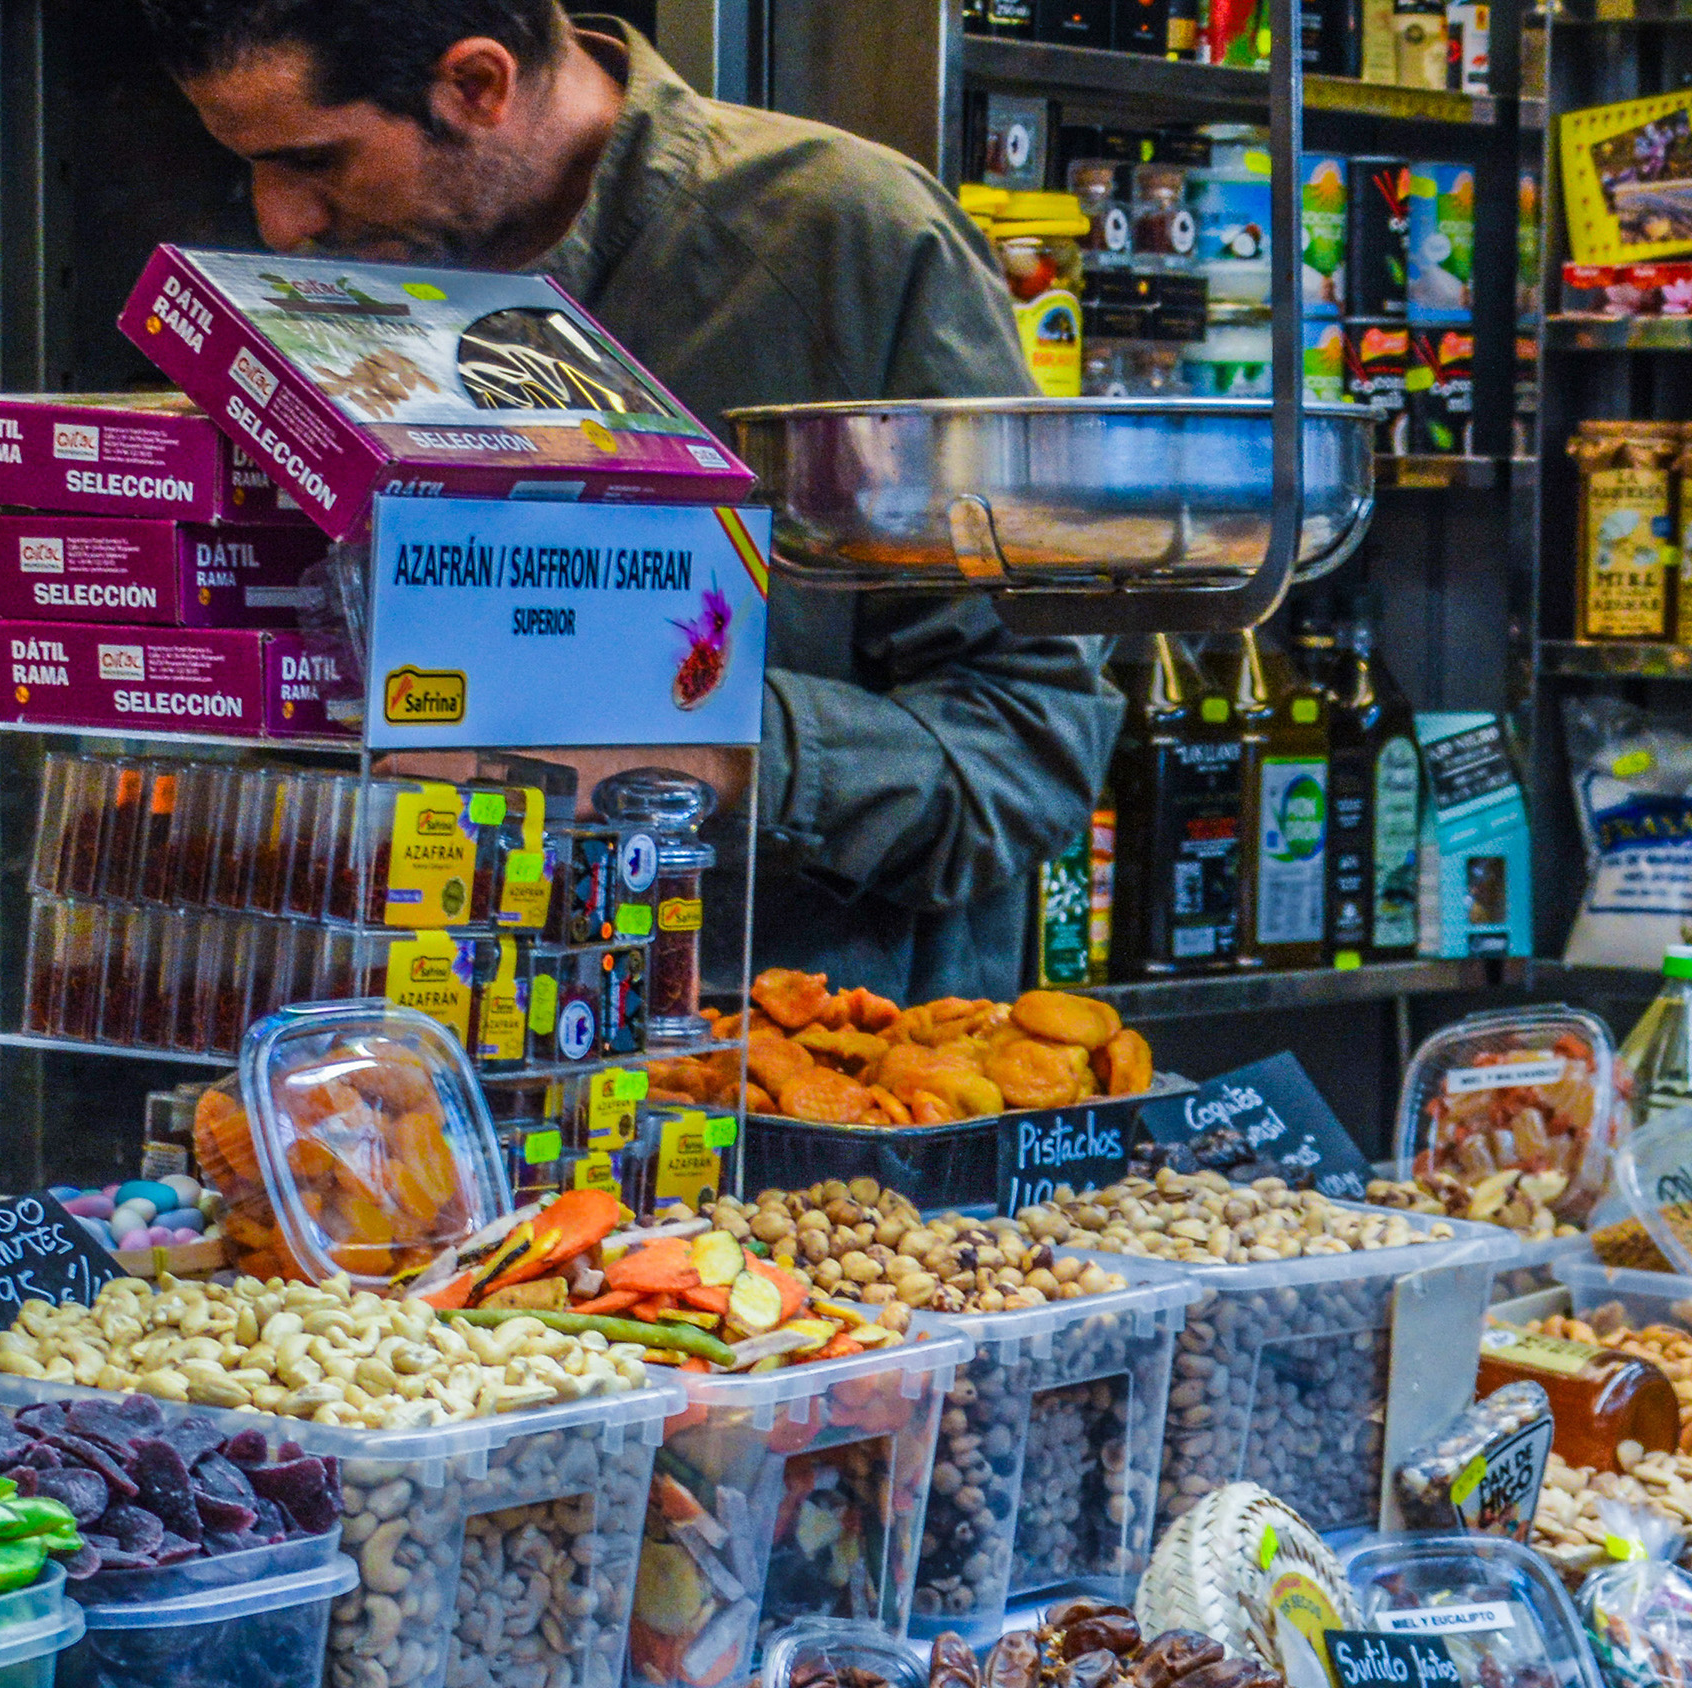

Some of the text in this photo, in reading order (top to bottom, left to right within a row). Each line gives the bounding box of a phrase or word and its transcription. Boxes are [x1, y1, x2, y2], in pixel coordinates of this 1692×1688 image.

[162, 275, 214, 335] DÁTIL
[153, 297, 205, 355] RAMA
[226, 395, 337, 511] SELECCIÓN
[408, 430, 537, 454] SELECCIÓN
[66, 469, 194, 502] SELECCIÓN
[196, 541, 260, 568] DÁTIL
[394, 537, 493, 587] AZAFRÁN
[509, 547, 598, 589] SAFFRON
[615, 550, 692, 591] SAFRAN
[197, 570, 237, 588] RAMA
[1595, 572, 1657, 588] MIEL
[34, 581, 157, 608] SELECCIÓN
[513, 607, 576, 636] SUPERIOR
[11, 636, 69, 663] DÁTIL
[12, 664, 69, 686] RAMA
[281, 653, 340, 681] DÁTIL
[114, 690, 242, 717] SELECCIÓN
[281, 684, 320, 700] RAMA
[404, 691, 460, 713] Safrina
[405, 842, 464, 860] AZAFRÁN
[398, 988, 458, 1006] AZAFRÁN
[1018, 1110, 1123, 1169] Pistachos
[1480, 1442, 1534, 1490] PAN DE
[1480, 1464, 1533, 1510] HIGO
[1392, 1610, 1495, 1630] MIEL Y EUCALIPTO
[1335, 1638, 1408, 1685] Surtido
